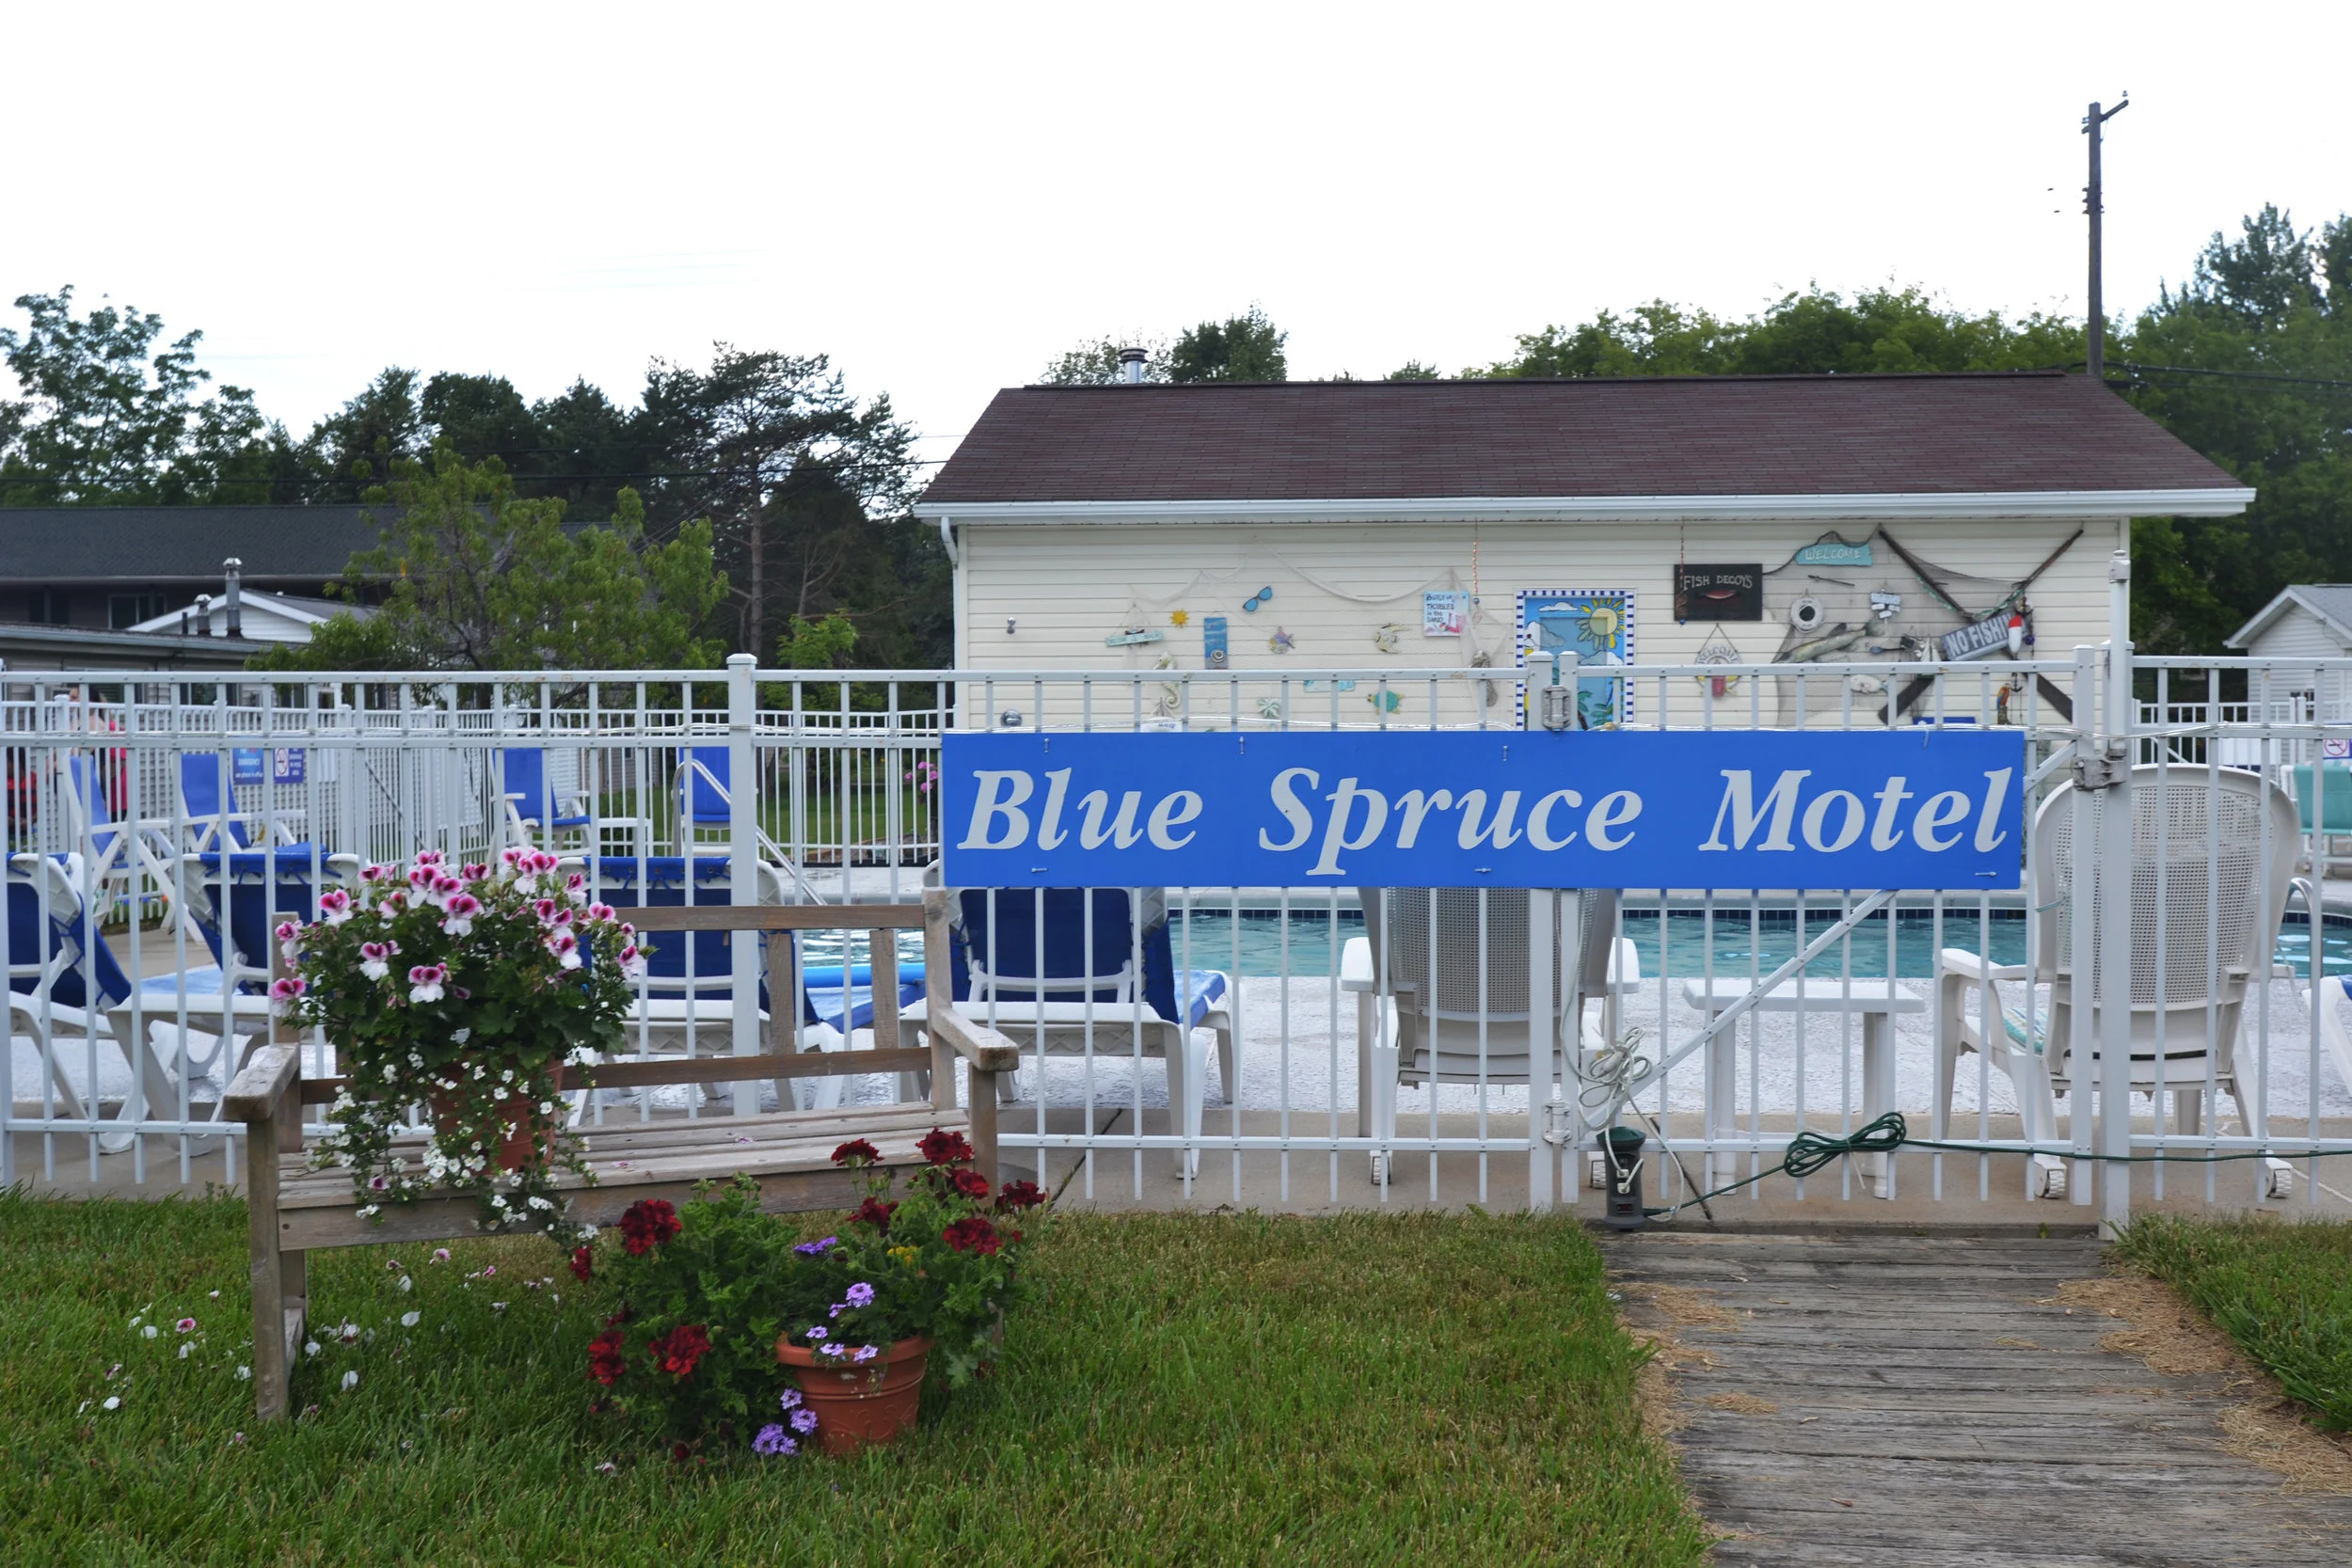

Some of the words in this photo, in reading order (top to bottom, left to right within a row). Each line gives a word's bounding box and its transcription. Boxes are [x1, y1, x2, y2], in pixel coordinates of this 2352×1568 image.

[1805, 548, 1862, 561] WELCOME
[1683, 575, 1710, 591] FISH
[1716, 574, 1753, 589] DECOYS
[1945, 630, 1970, 657] NO
[957, 768, 1202, 850] Blue
[1260, 768, 1642, 875] Spruce
[1699, 768, 2011, 852] Motel
